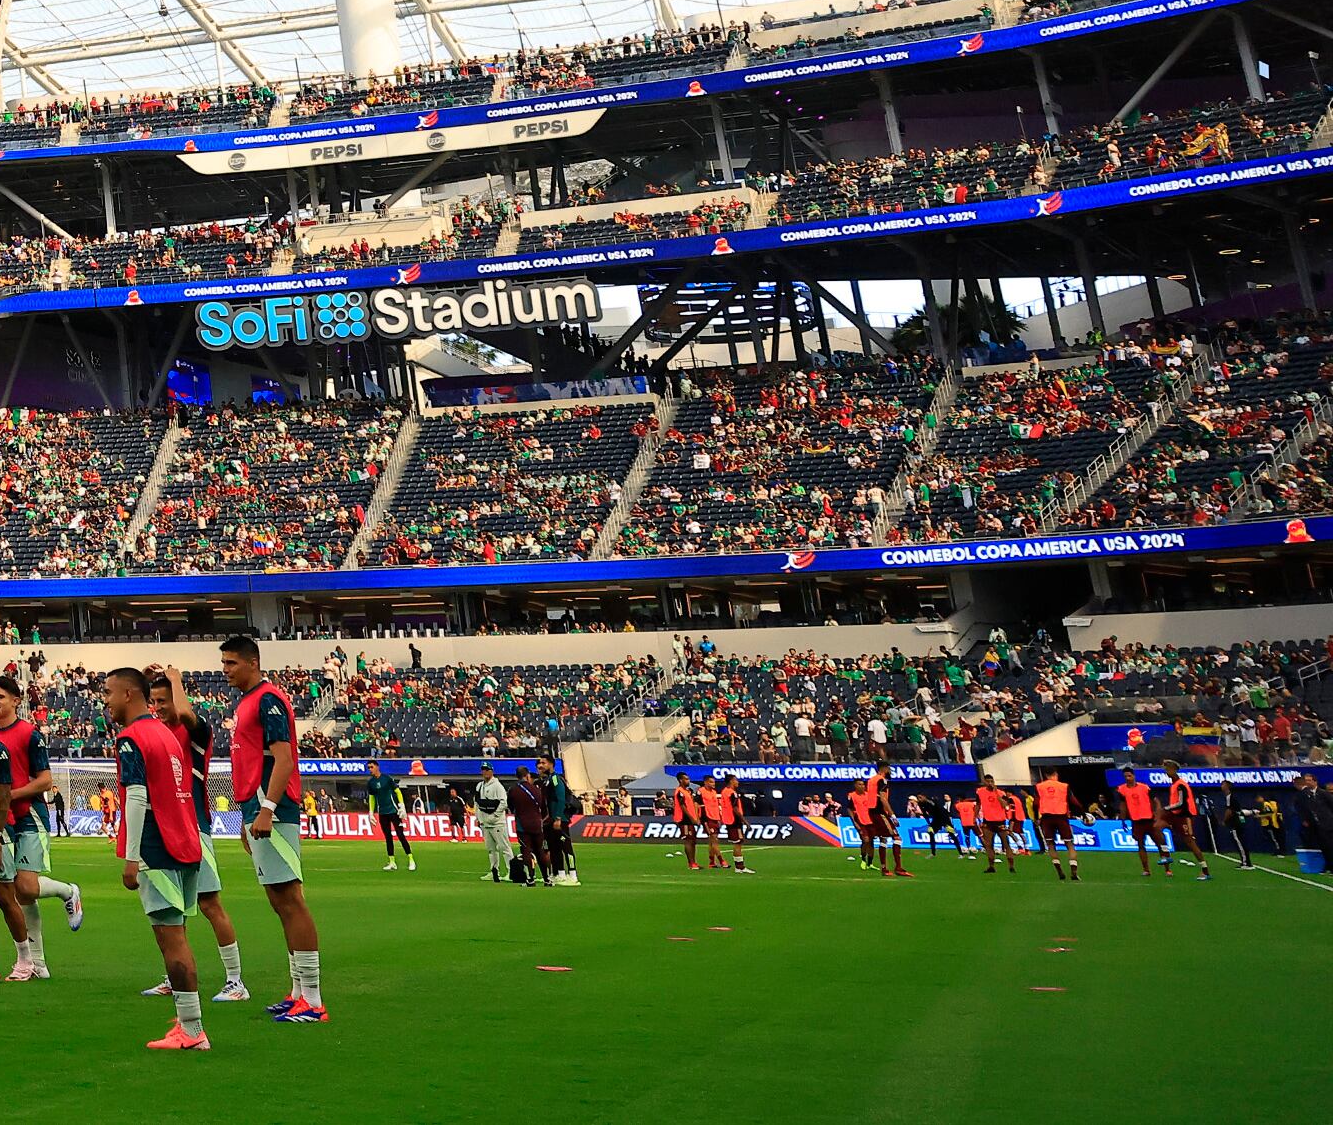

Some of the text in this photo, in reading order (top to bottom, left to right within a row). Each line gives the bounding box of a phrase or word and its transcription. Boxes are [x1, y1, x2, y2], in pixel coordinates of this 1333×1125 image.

[1039, 19, 1095, 37] CONMEBOL
[1094, 13, 1122, 26] COPA
[1121, 4, 1167, 21] AMERICA
[1166, 0, 1189, 10] USA
[744, 51, 909, 83] CONMEBOL COPA AMERICA USA 2024
[233, 123, 376, 145] CONMEBOL COPA AMERICA USA 2024
[513, 119, 569, 139] PEPSI
[310, 143, 363, 161] PEPSI
[1129, 155, 1333, 197] CONMEBOL COPA AMERICA USA 202
[780, 210, 977, 242] CONMEBOL COPA AMERICA USA 2024
[199, 279, 598, 346] SoFi Stadium
[881, 532, 1185, 565] CONMEBOL COPA AMERICA USA 2024
[320, 762, 340, 773] USA
[340, 762, 365, 773] 2024
[784, 767, 820, 779] COPA
[907, 766, 940, 779] 2024
